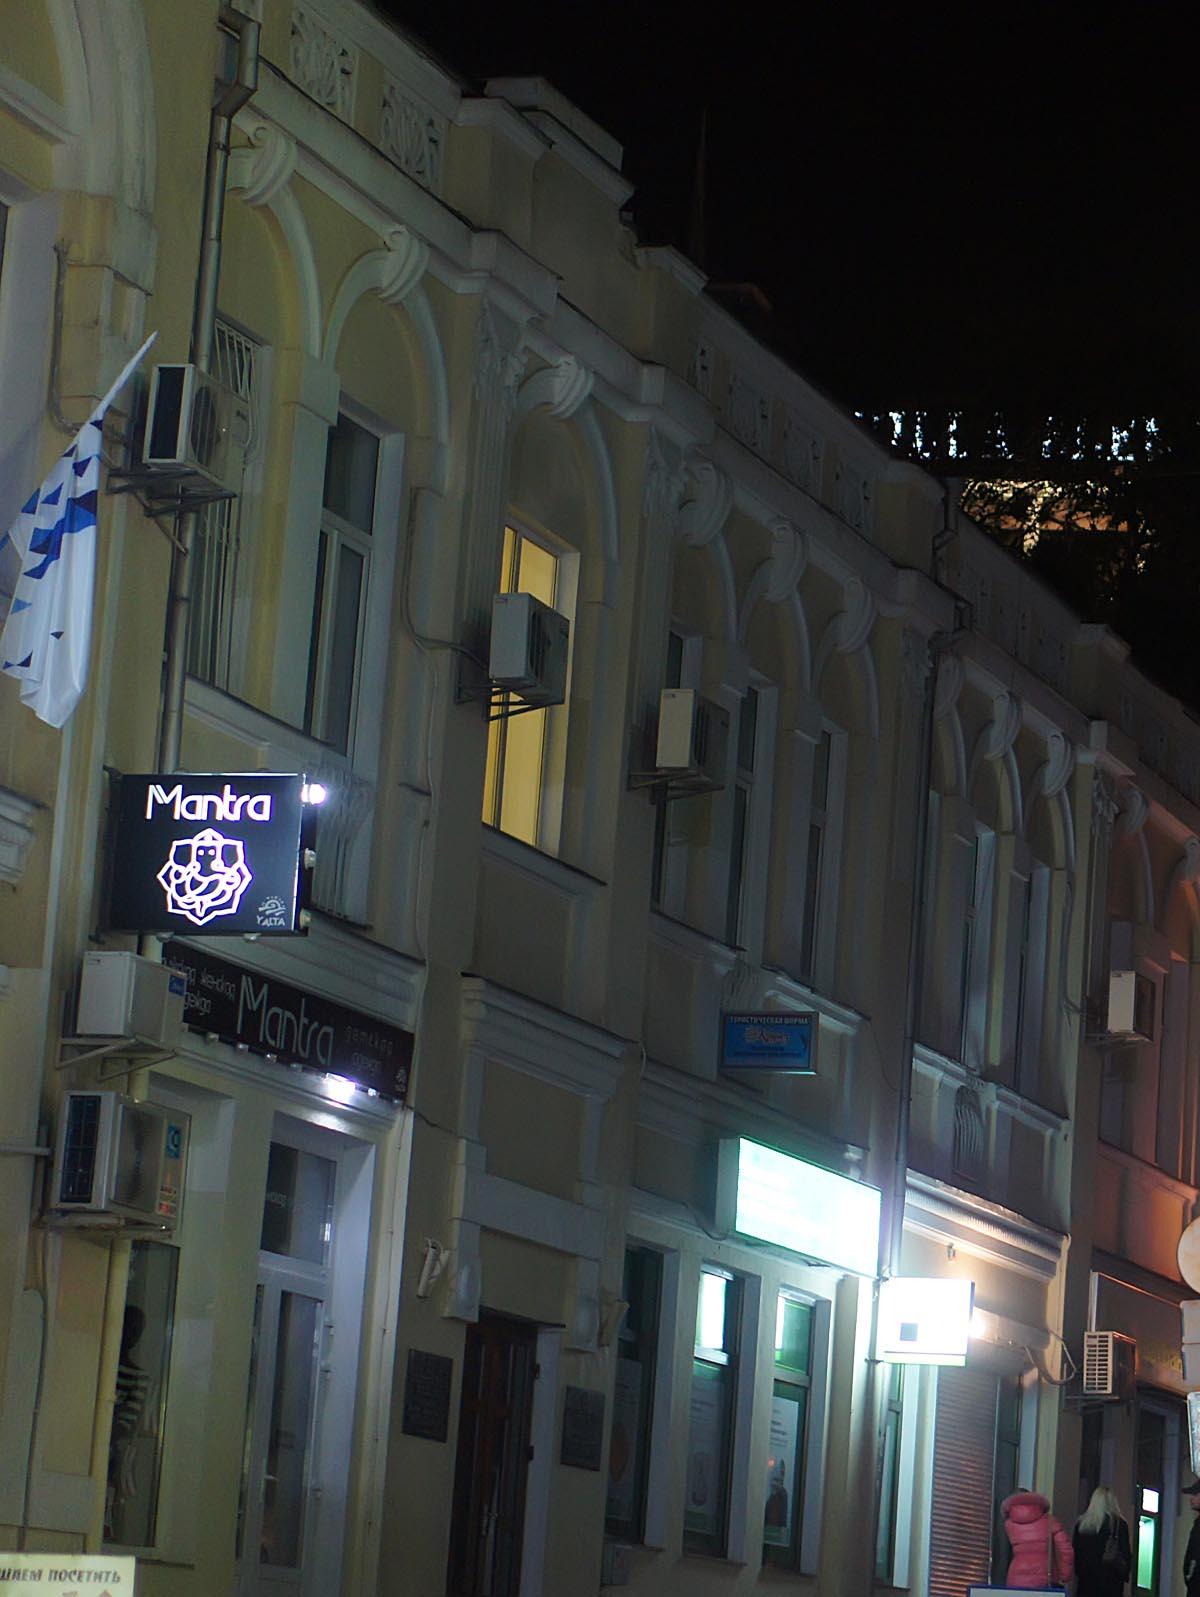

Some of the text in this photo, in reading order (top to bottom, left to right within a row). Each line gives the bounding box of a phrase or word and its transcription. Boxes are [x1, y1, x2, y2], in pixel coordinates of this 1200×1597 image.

[146, 784, 272, 822] Mantra
[236, 974, 336, 1067] Mantra
[48, 1568, 121, 1584] ПОСЕТИТЬ
